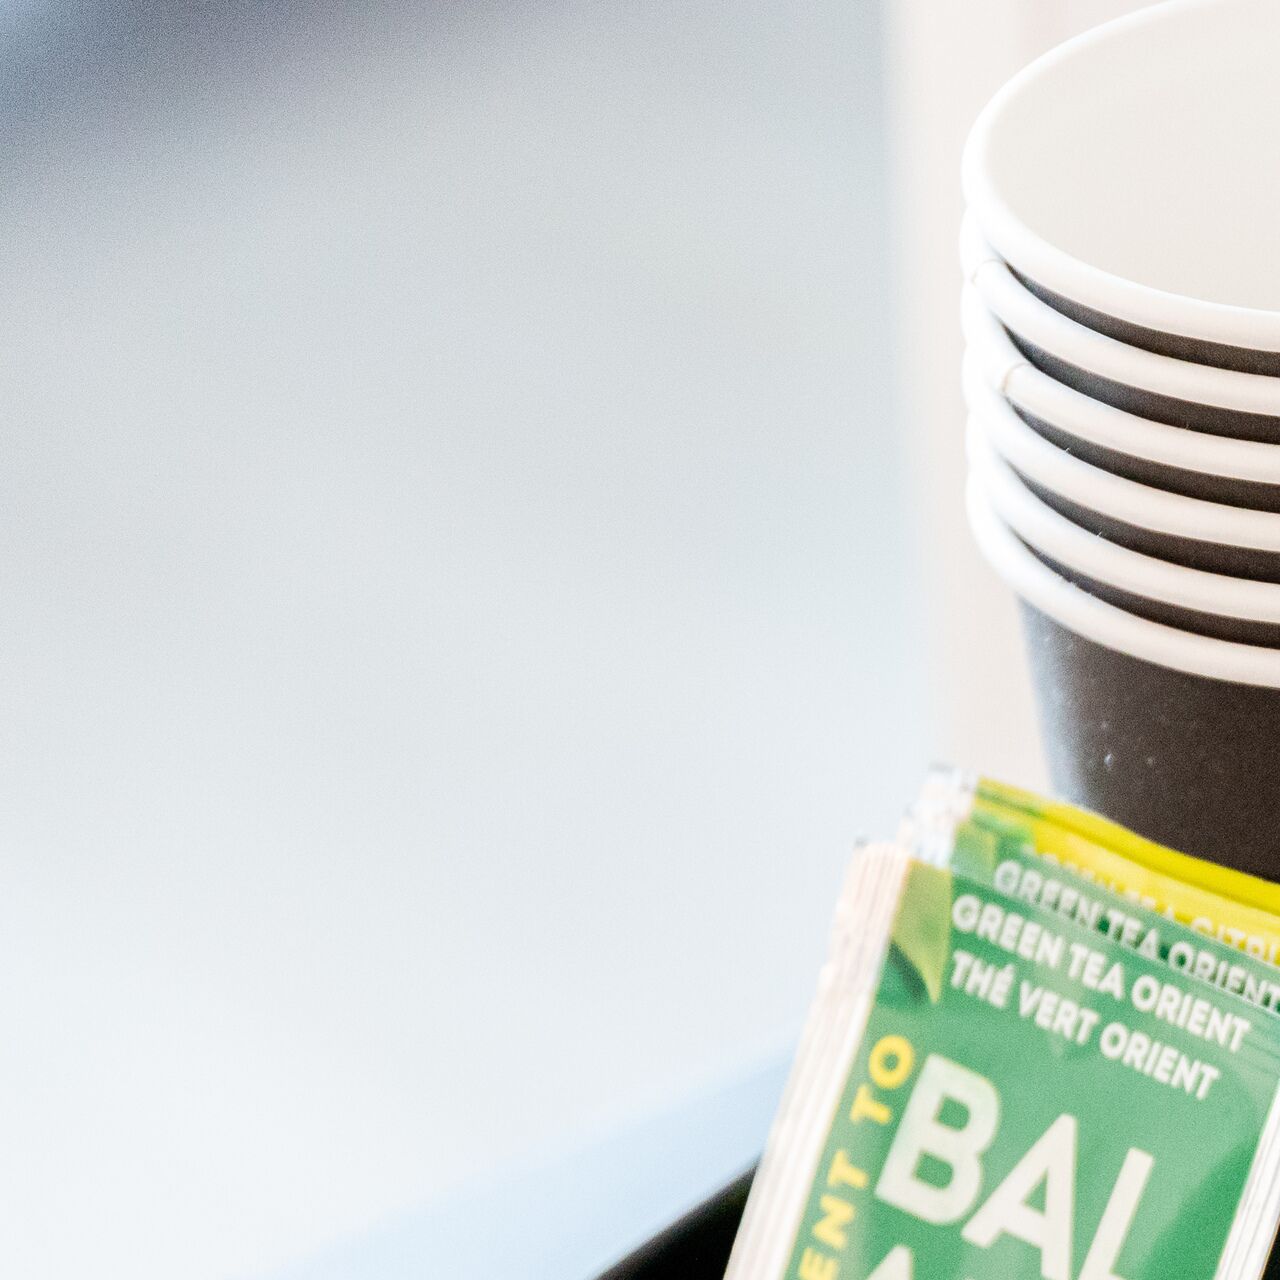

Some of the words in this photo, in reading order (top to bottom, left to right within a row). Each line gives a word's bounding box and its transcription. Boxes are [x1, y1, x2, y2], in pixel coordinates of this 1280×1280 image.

[993, 858, 1101, 934] GREEN
[1103, 909, 1162, 960] TEA
[948, 948, 1013, 1011] THÉ
[1017, 987, 1101, 1056] VERT
[1100, 1028, 1221, 1102] ORIENT
[951, 894, 1061, 972] GREEN
[1064, 941, 1127, 1001] TEA
[1131, 975, 1253, 1054] ORIENT
[850, 1033, 917, 1127] TO
